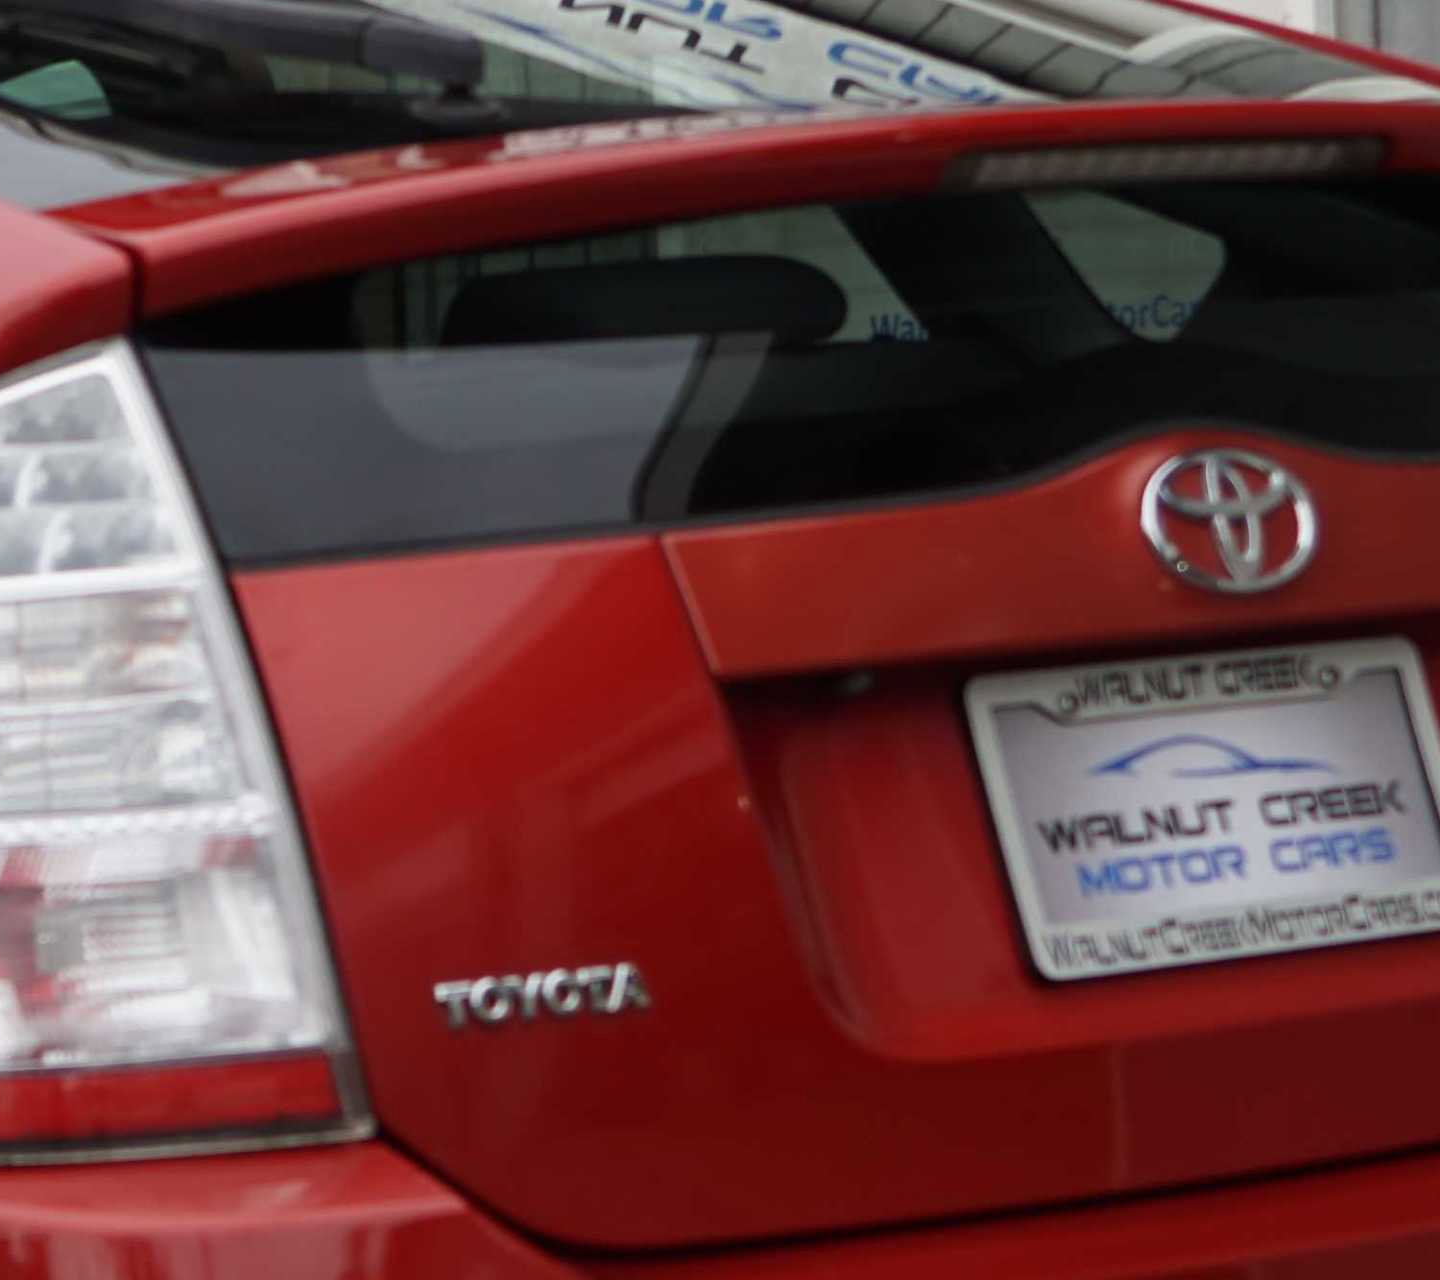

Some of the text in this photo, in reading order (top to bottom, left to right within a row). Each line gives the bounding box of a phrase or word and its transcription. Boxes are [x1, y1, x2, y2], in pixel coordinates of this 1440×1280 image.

[1075, 652, 1311, 707] WALNUT CREEK
[1037, 779, 1404, 855] WALNUT CREEK
[1077, 827, 1395, 896] MOTOR CARS
[432, 960, 653, 1030] TOYOTA
